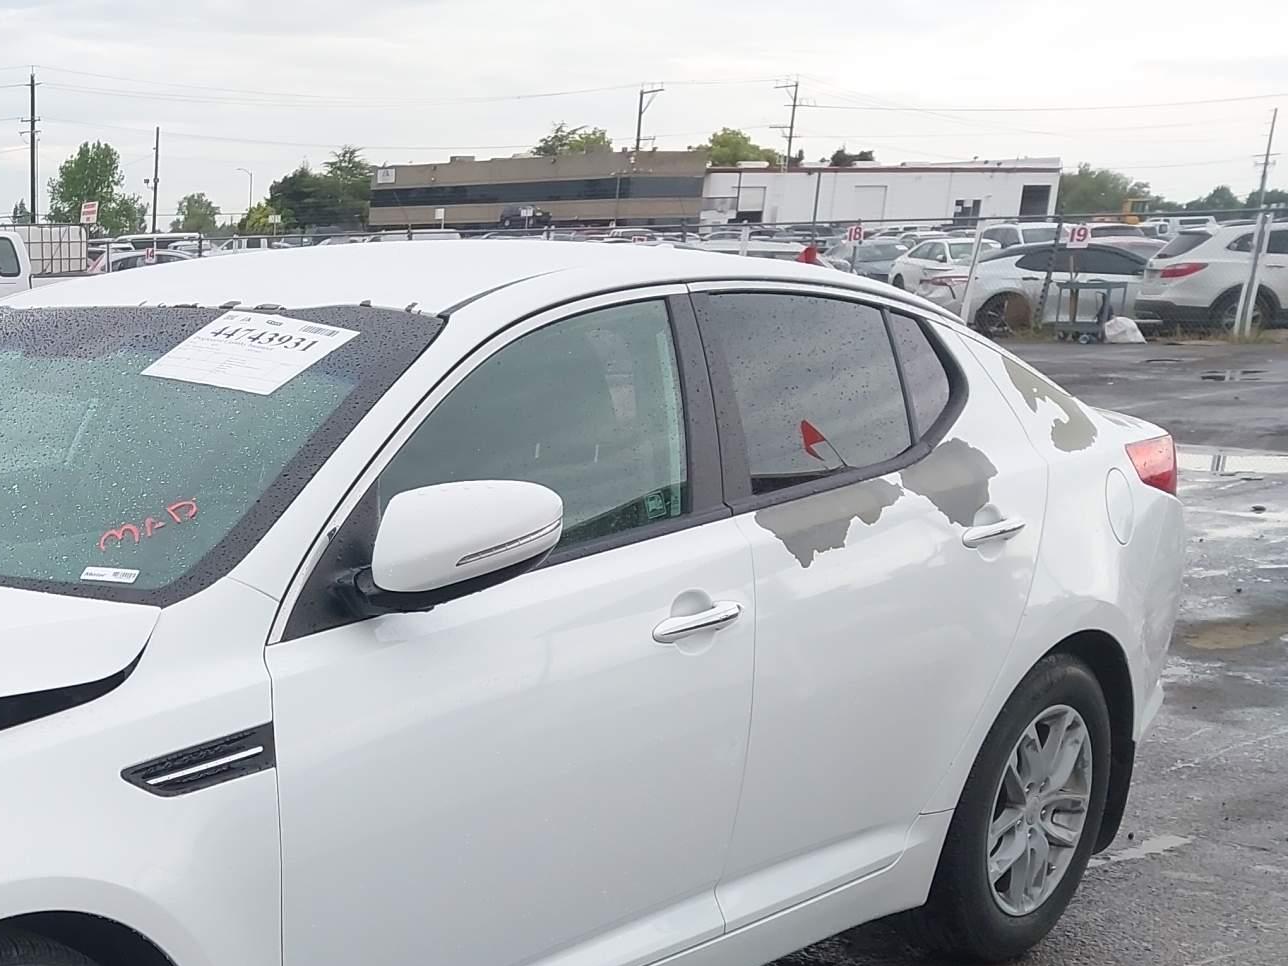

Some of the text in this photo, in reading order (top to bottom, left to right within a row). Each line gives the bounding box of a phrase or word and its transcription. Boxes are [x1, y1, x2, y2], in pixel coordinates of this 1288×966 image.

[848, 226, 862, 241] 18
[1069, 227, 1088, 242] 19
[210, 325, 319, 351] 44743931
